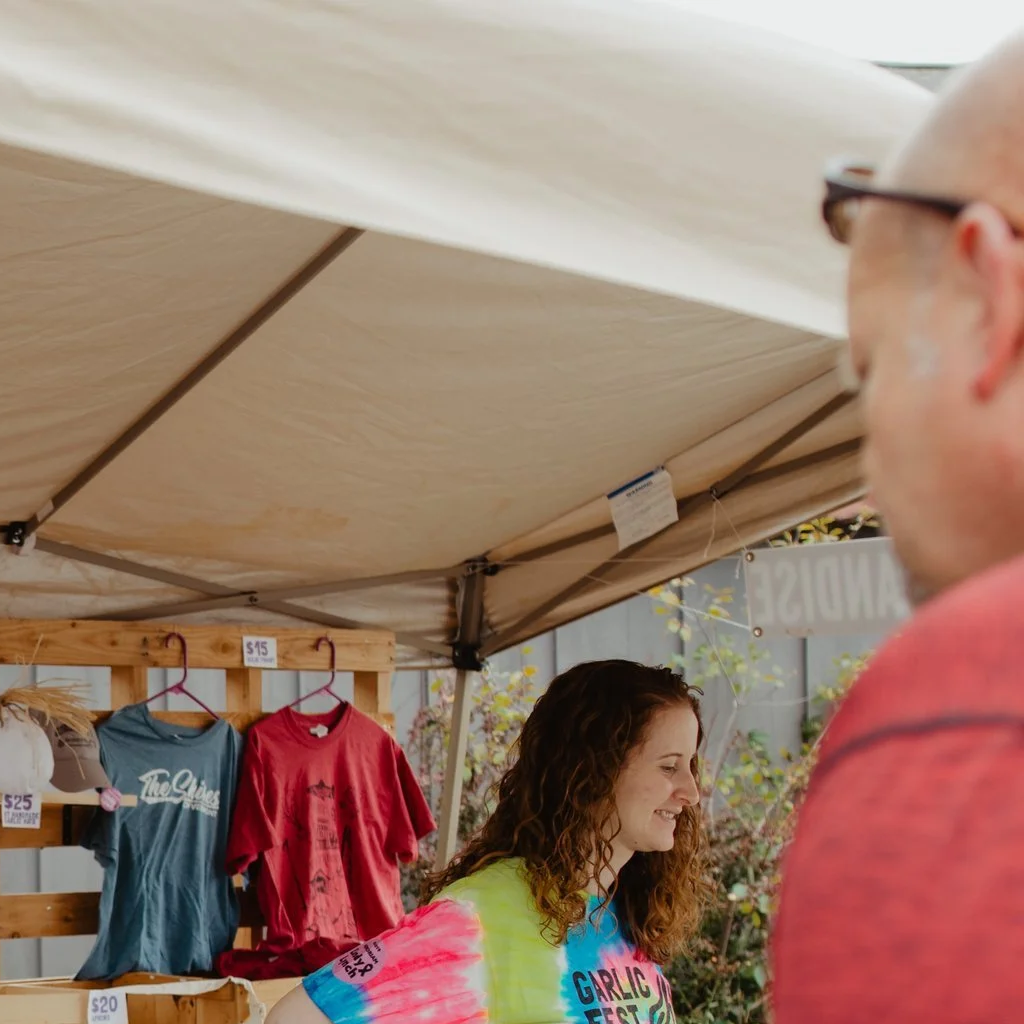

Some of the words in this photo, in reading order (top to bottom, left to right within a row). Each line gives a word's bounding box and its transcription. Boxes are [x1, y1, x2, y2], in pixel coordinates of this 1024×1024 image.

[246, 640, 269, 656] $15
[4, 794, 33, 811] $25
[572, 966, 651, 1005] GARLIC
[91, 996, 118, 1014] $20
